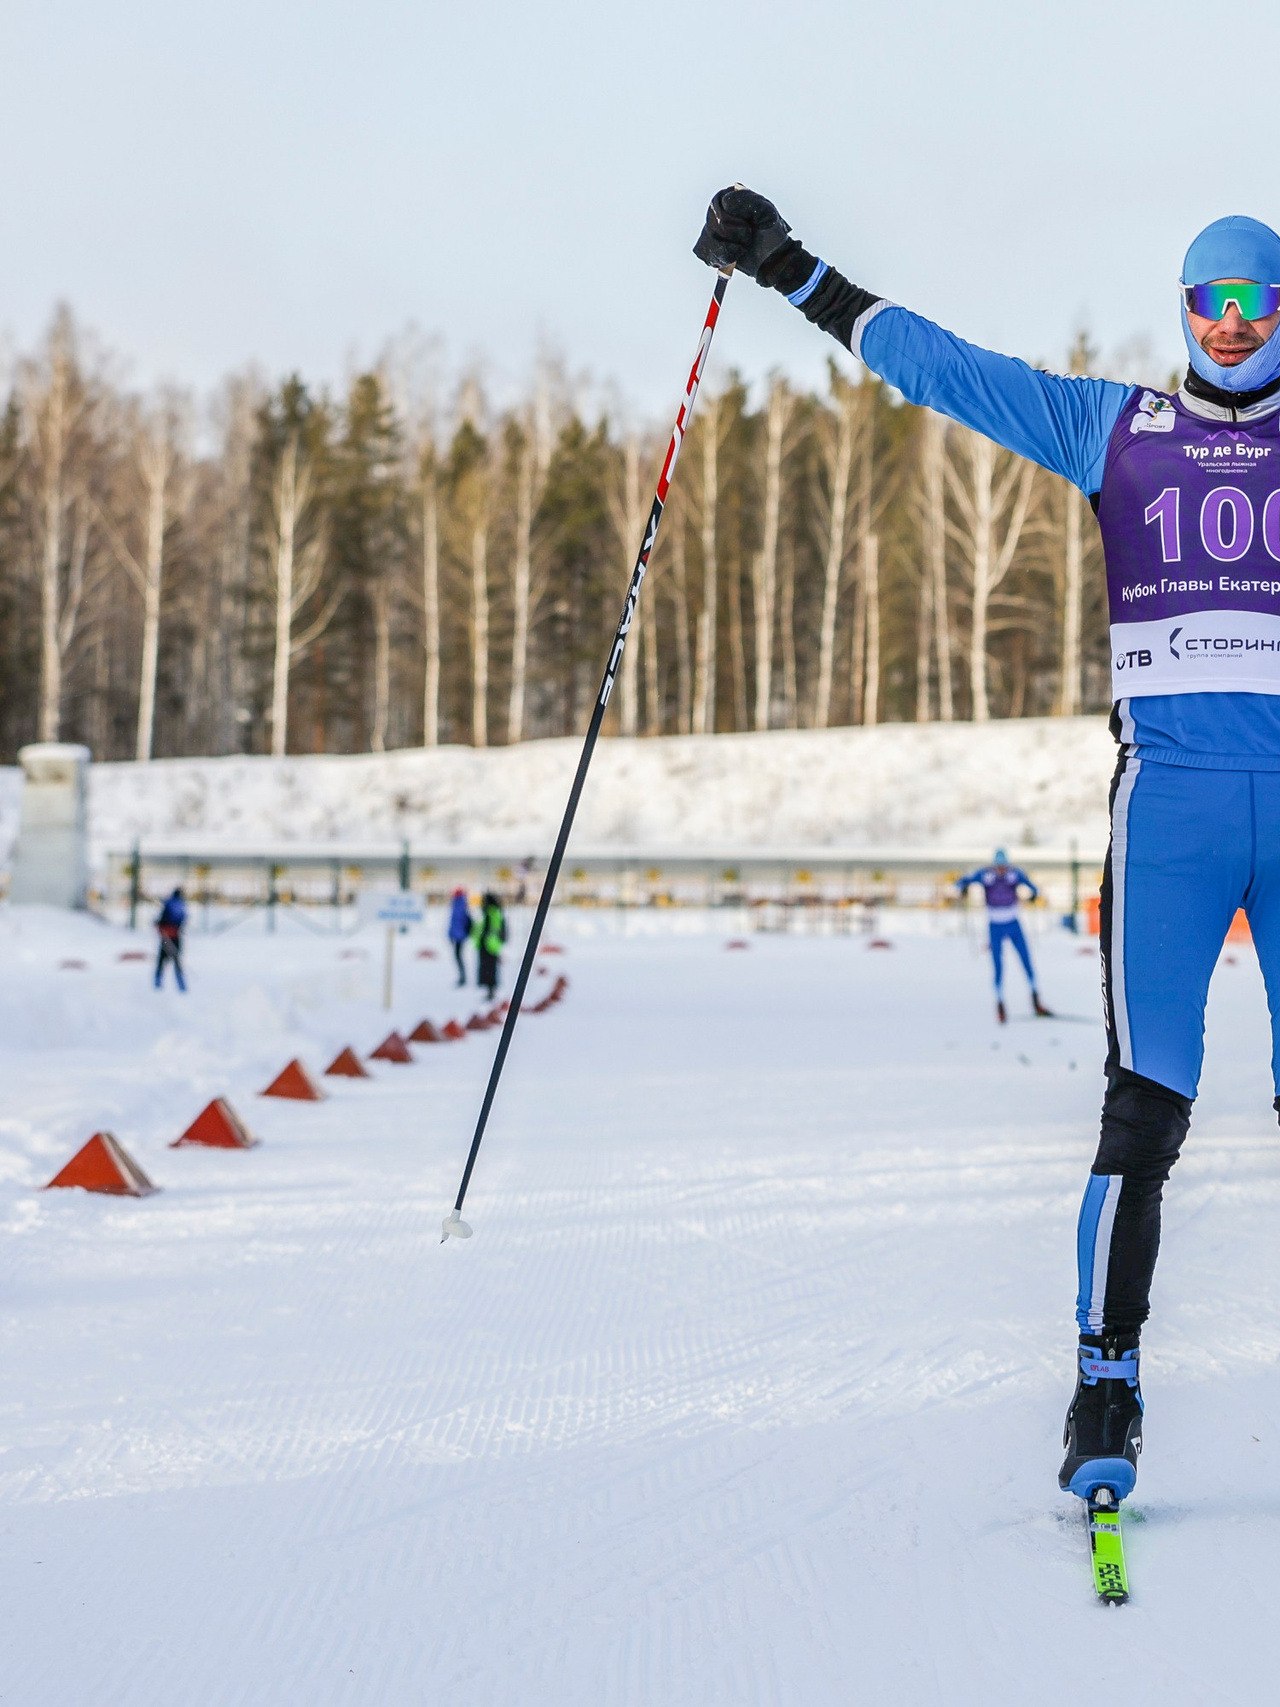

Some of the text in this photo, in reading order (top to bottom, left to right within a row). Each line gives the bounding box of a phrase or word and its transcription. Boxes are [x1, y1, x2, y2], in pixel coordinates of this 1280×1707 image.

[1183, 443, 1272, 459] Тур де Бург
[1122, 583, 1157, 602] Кубок
[1161, 578, 1213, 594] Главы
